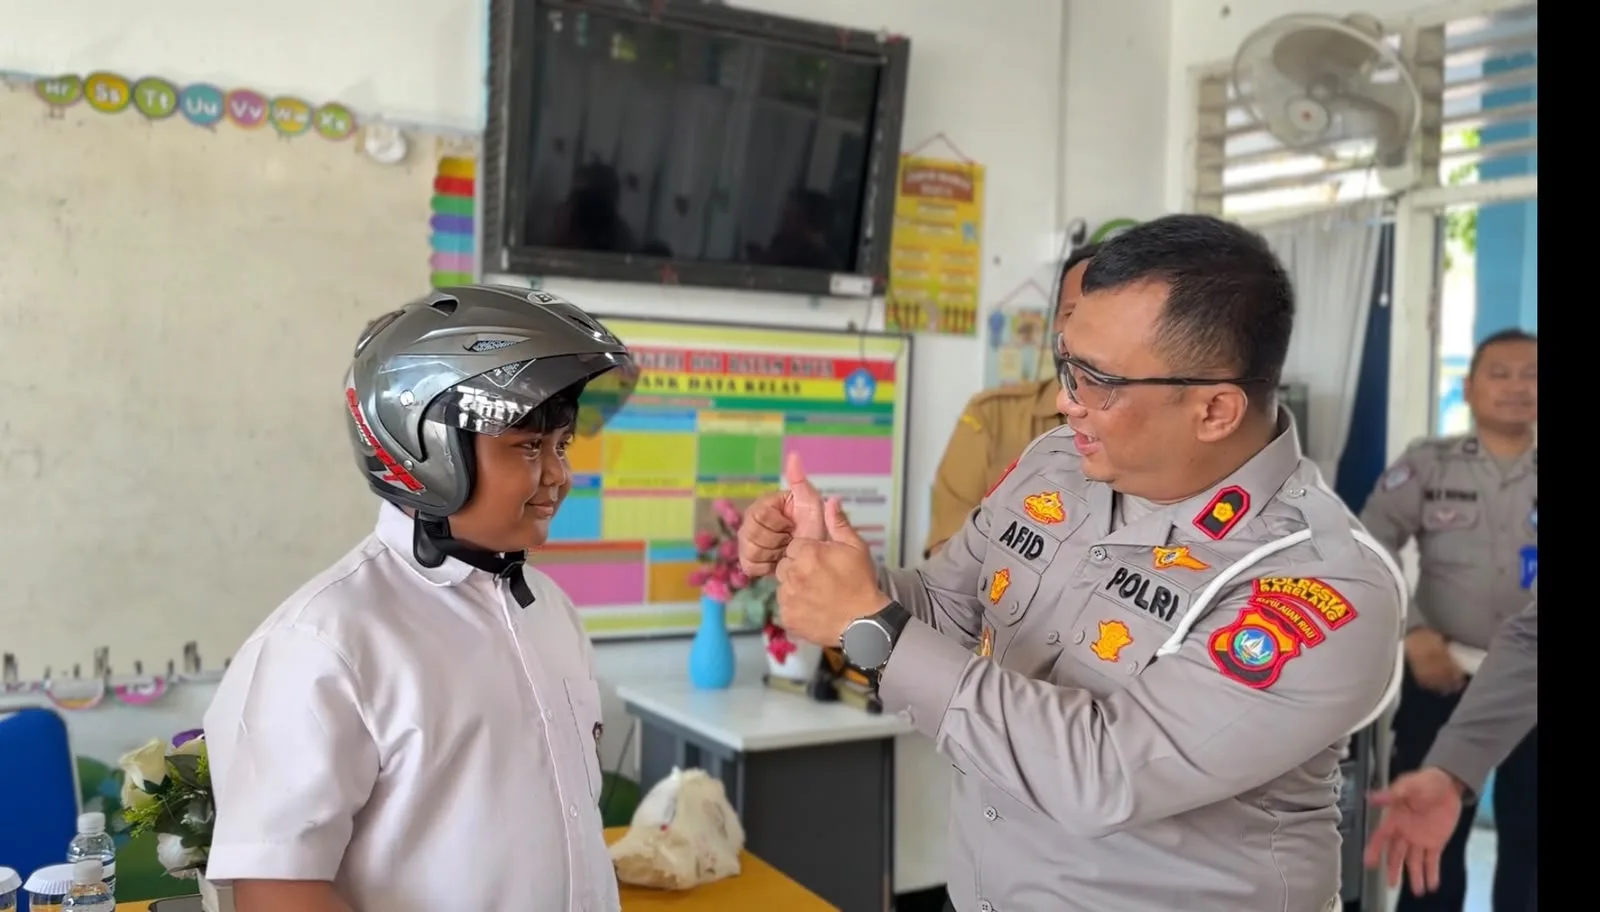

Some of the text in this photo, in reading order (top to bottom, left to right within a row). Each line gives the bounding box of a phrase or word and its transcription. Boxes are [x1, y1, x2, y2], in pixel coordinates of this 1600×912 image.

[143, 88, 168, 110] Tt
[186, 97, 217, 116] Uu
[231, 100, 262, 119] Vv
[688, 377, 737, 392] DATA
[744, 380, 802, 395] KELAS
[999, 520, 1044, 561] AFID
[1105, 567, 1180, 622] POLRI
[1260, 577, 1348, 618] POLRESTA
[1260, 583, 1338, 621] BARELANG
[1298, 620, 1316, 639] RIAU
